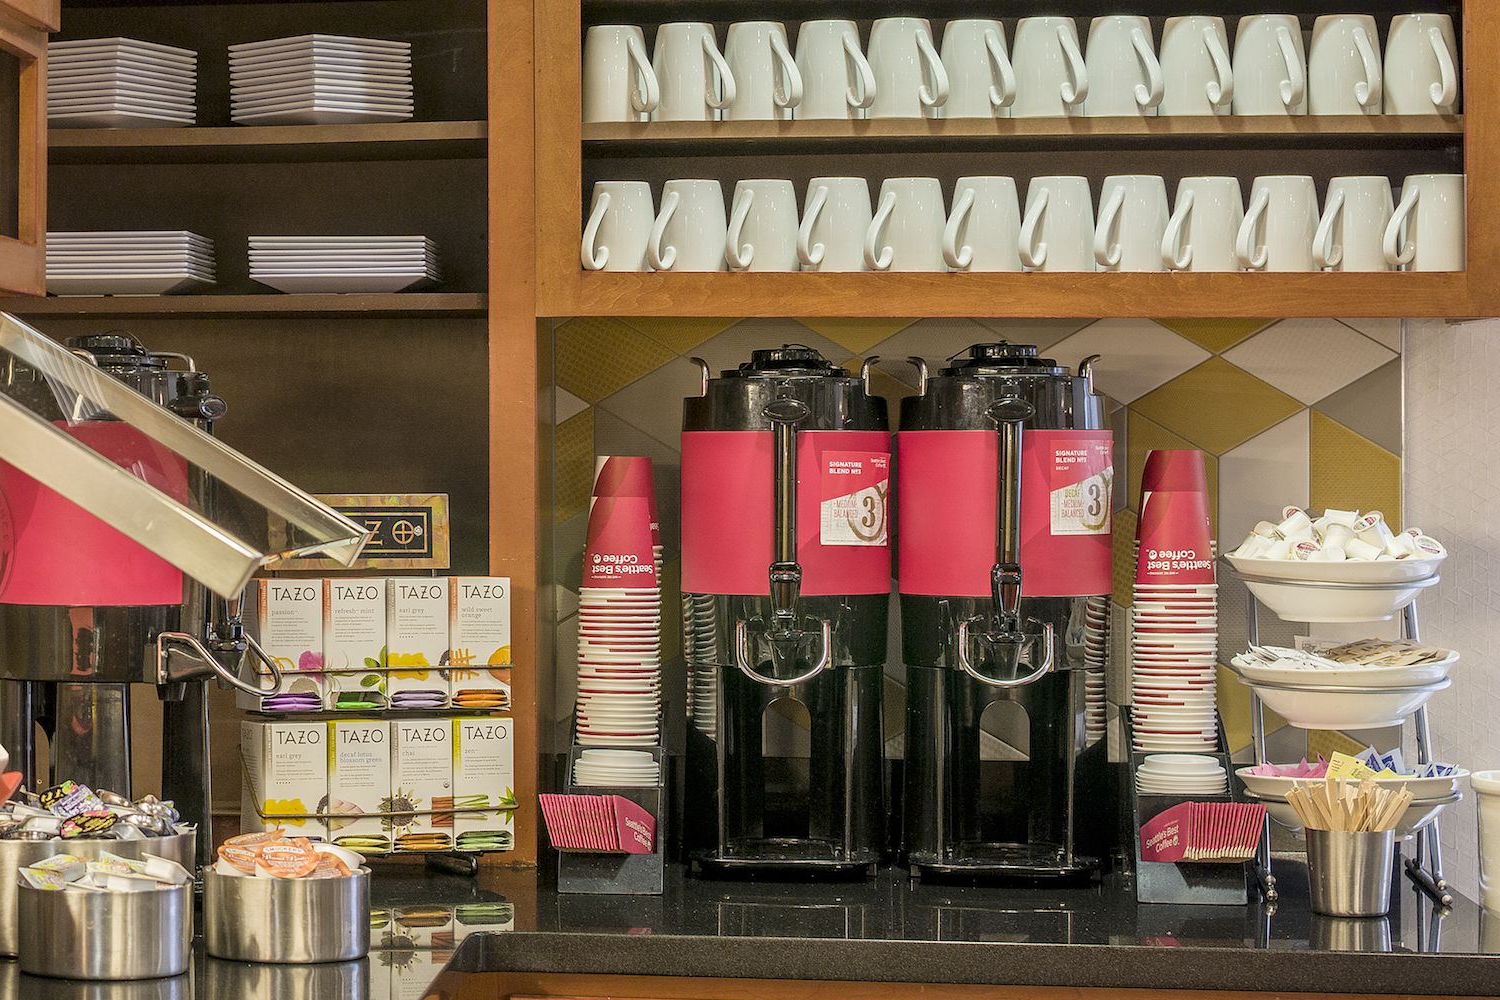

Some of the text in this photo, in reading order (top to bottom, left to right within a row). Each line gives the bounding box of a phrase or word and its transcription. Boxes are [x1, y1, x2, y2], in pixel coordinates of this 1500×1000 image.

[1088, 484, 1101, 516] 3
[862, 495, 876, 528] 3
[603, 554, 638, 564] Coffee
[1158, 550, 1196, 560] Coffee
[592, 564, 653, 574] Seattle's Best
[1147, 560, 1211, 571] Seattle's Best
[272, 587, 316, 601] TAZO
[335, 586, 379, 600] TAZO
[399, 585, 442, 599] TAZO
[462, 585, 504, 599] TAZO
[276, 730, 320, 744] TAZO
[340, 729, 384, 743] TAZO
[402, 728, 445, 742] TAZO
[465, 725, 507, 740] TAZO
